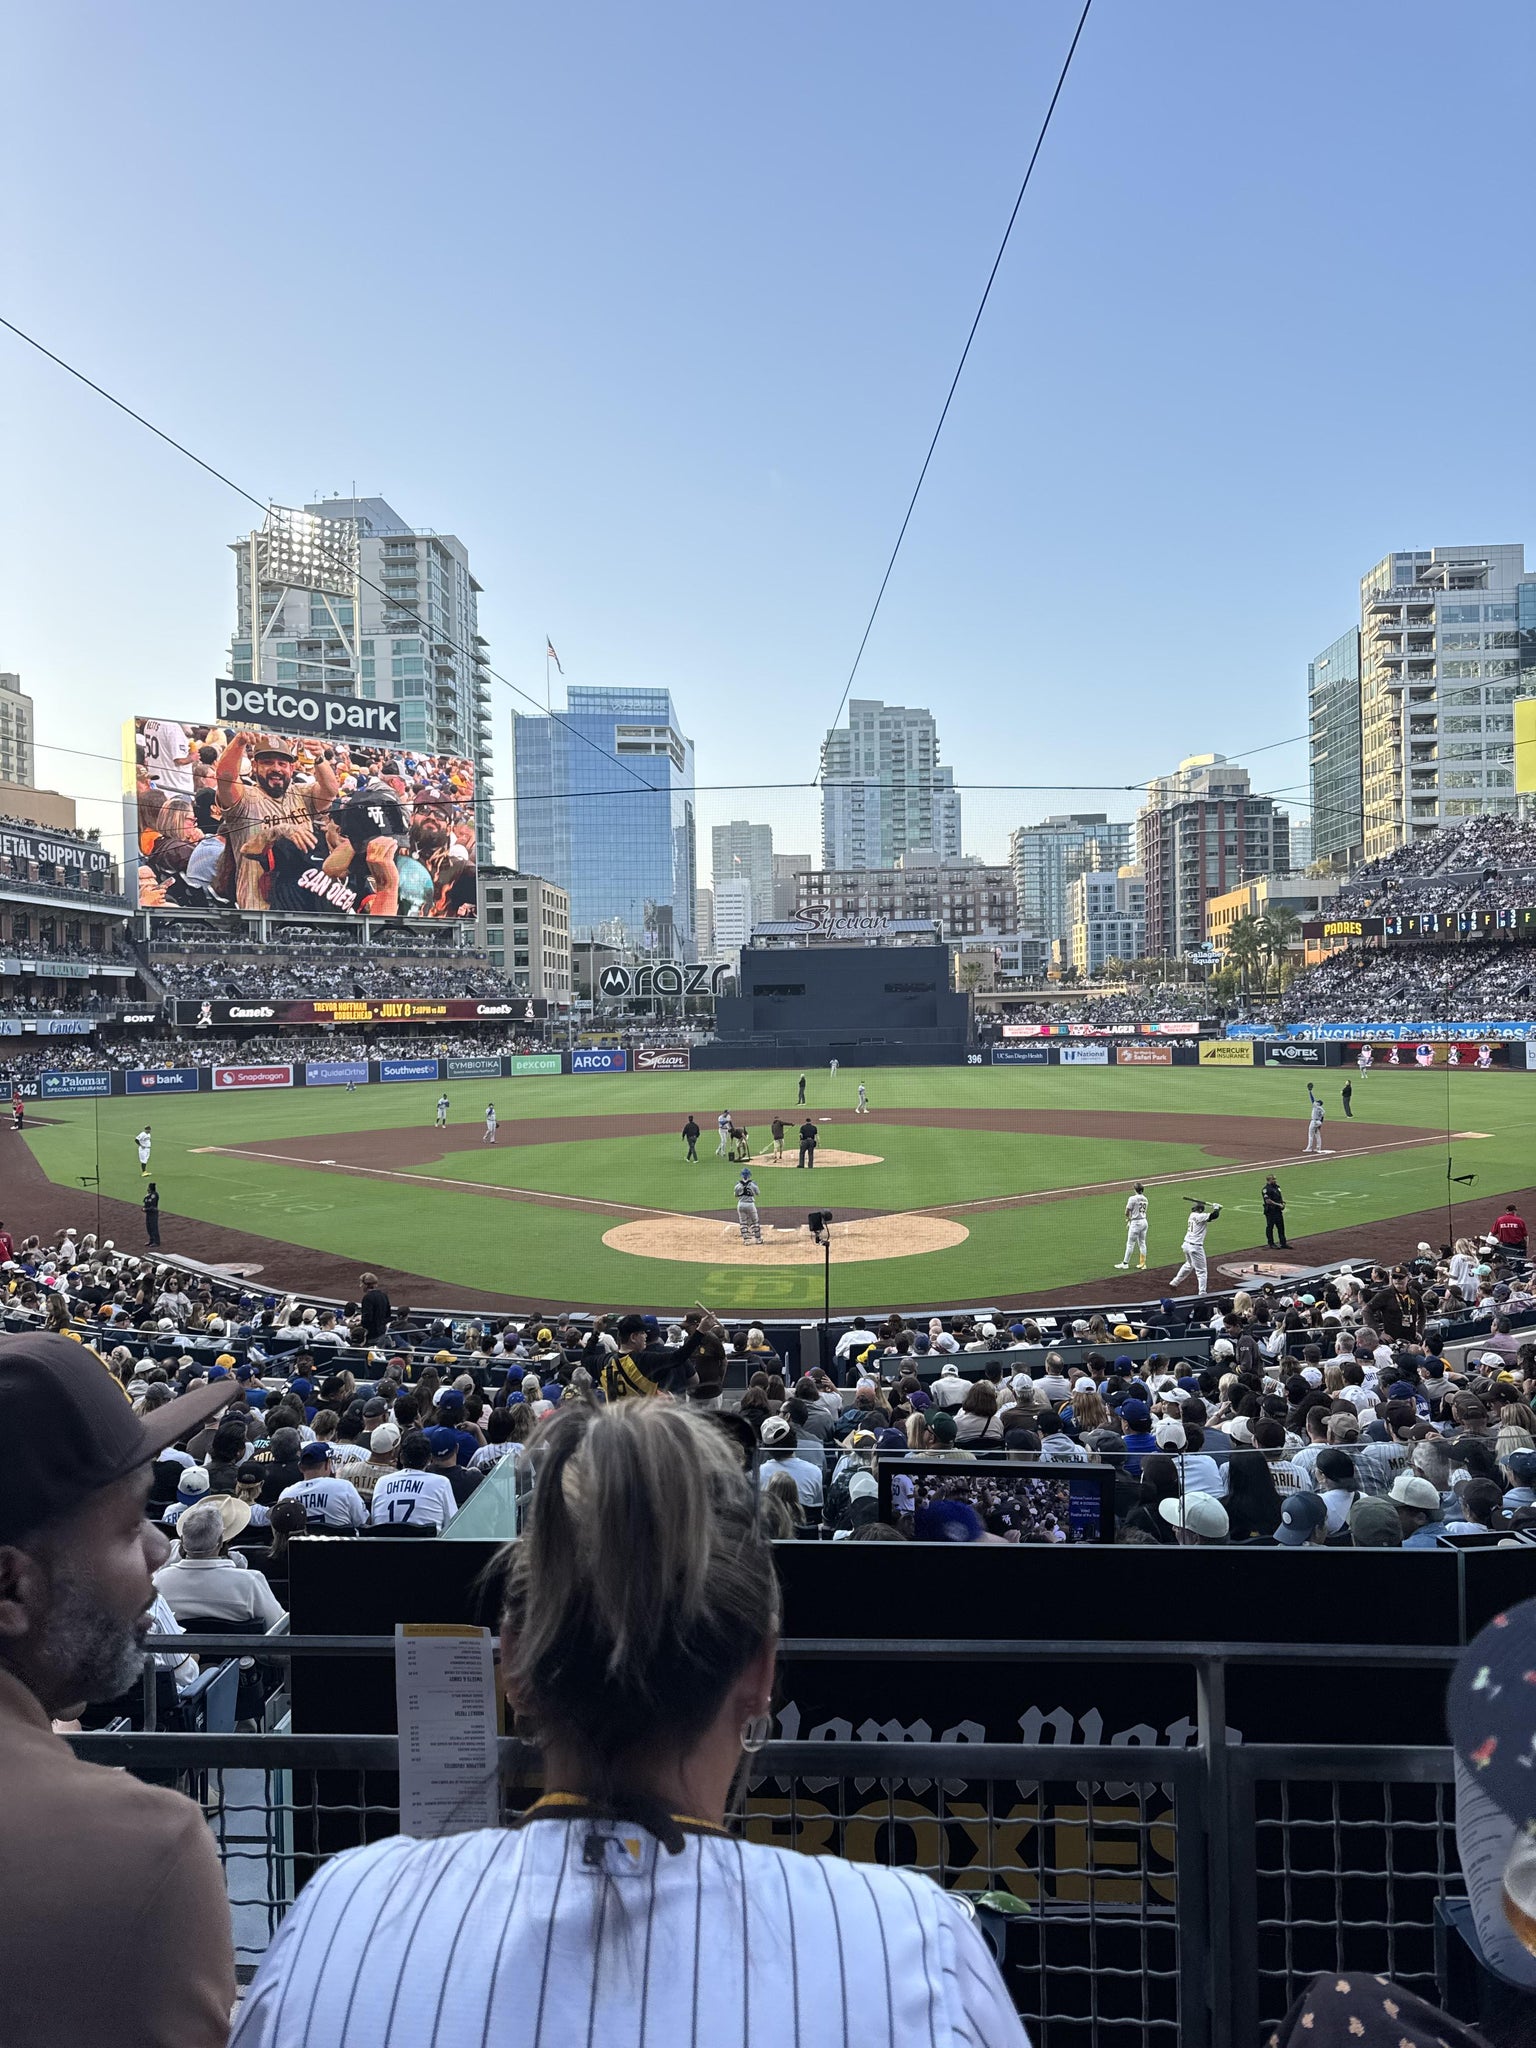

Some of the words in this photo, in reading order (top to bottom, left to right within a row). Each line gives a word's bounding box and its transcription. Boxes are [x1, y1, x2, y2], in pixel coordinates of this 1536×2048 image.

[220, 686, 320, 722] petco
[325, 701, 398, 733] park
[0, 834, 35, 860] ETAL
[38, 843, 86, 869] SUPPLY
[297, 868, 332, 897] SAN
[326, 882, 359, 913] DIEG
[794, 904, 889, 939] Sycuan
[1485, 915, 1491, 925] F
[1510, 909, 1516, 919] 3
[1525, 912, 1531, 923] F
[1409, 919, 1415, 930] F
[1433, 923, 1439, 933] 4
[1446, 917, 1452, 928] F
[1471, 920, 1477, 930] 5
[1510, 918, 1517, 928] 2
[1324, 922, 1362, 938] PADRES
[1396, 925, 1402, 935] 5
[1187, 951, 1225, 960] Gallagher
[1192, 958, 1220, 966] Square
[634, 963, 732, 997] razr
[229, 1006, 275, 1018] Canel's
[313, 1002, 338, 1012] TREVOR
[338, 1002, 367, 1012] HOFFMAN
[380, 1004, 403, 1017] JULY
[404, 1003, 411, 1017] 8
[476, 1003, 513, 1015] Canel's
[123, 1014, 156, 1023] SONY
[333, 1010, 373, 1020] BOBBLEHEAD
[1109, 1025, 1135, 1034] LAGER
[1014, 1052, 1027, 1060] Diego
[1077, 1050, 1105, 1058] National
[1271, 1046, 1318, 1059] EVOTEK
[574, 1055, 612, 1068] ARCO
[638, 1051, 684, 1069] Sycuan
[967, 1054, 982, 1064] 396
[320, 1068, 366, 1078] QuidelOrtho
[384, 1065, 429, 1076] Southwest
[62, 1076, 107, 1087] Palomar
[141, 1075, 155, 1085] us
[156, 1073, 184, 1085] bank
[237, 1072, 284, 1082] Snapdragon
[17, 1083, 38, 1096] 342
[1139, 1202, 1147, 1213] 29
[386, 1479, 424, 1495] OHTANI
[387, 1499, 416, 1523] 17
